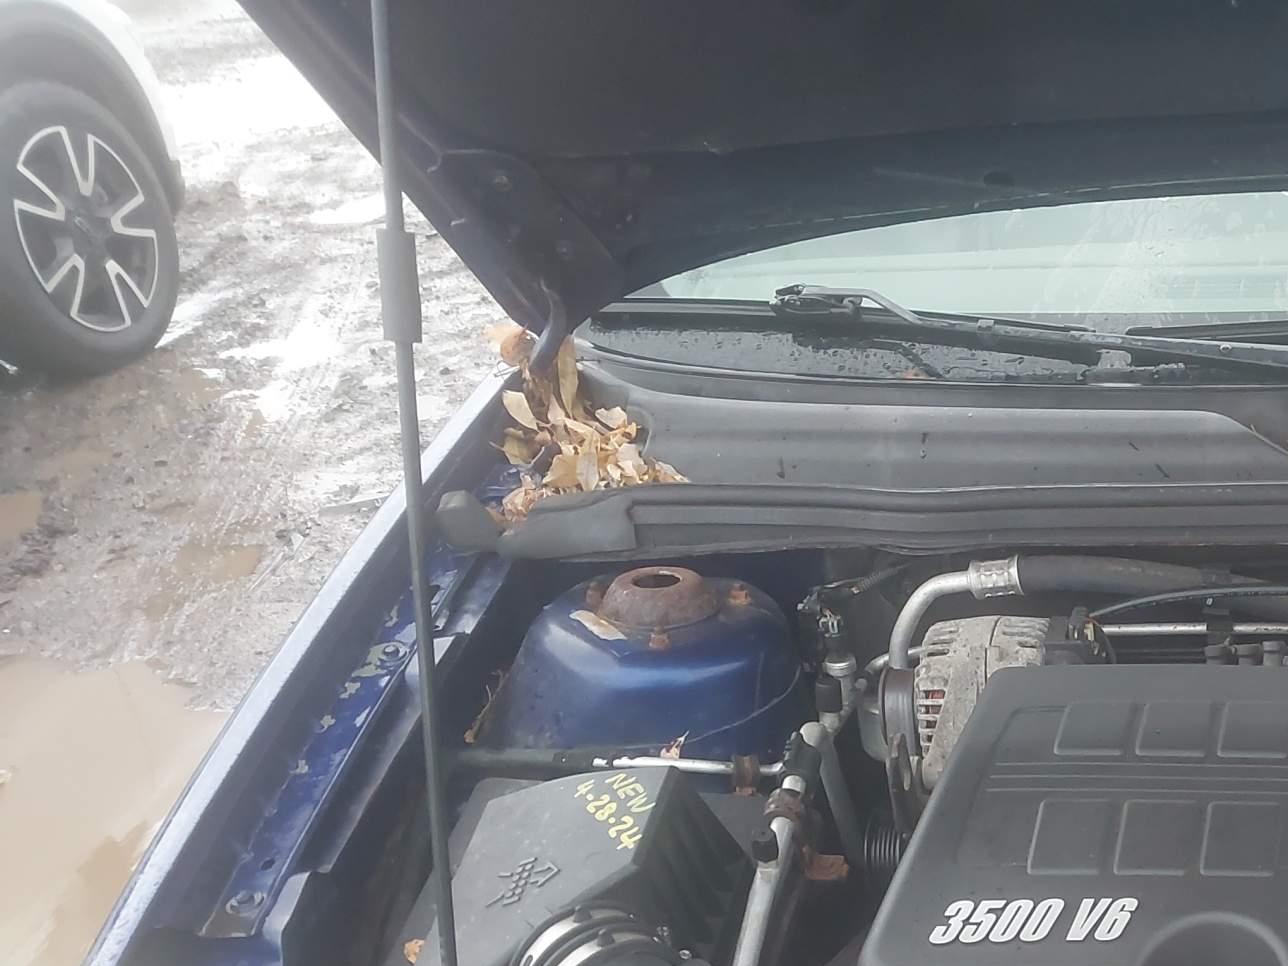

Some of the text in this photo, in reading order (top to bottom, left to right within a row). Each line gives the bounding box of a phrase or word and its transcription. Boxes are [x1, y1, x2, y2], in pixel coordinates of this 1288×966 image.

[604, 773, 657, 813] NEW
[928, 897, 1139, 945] 3500 V6
